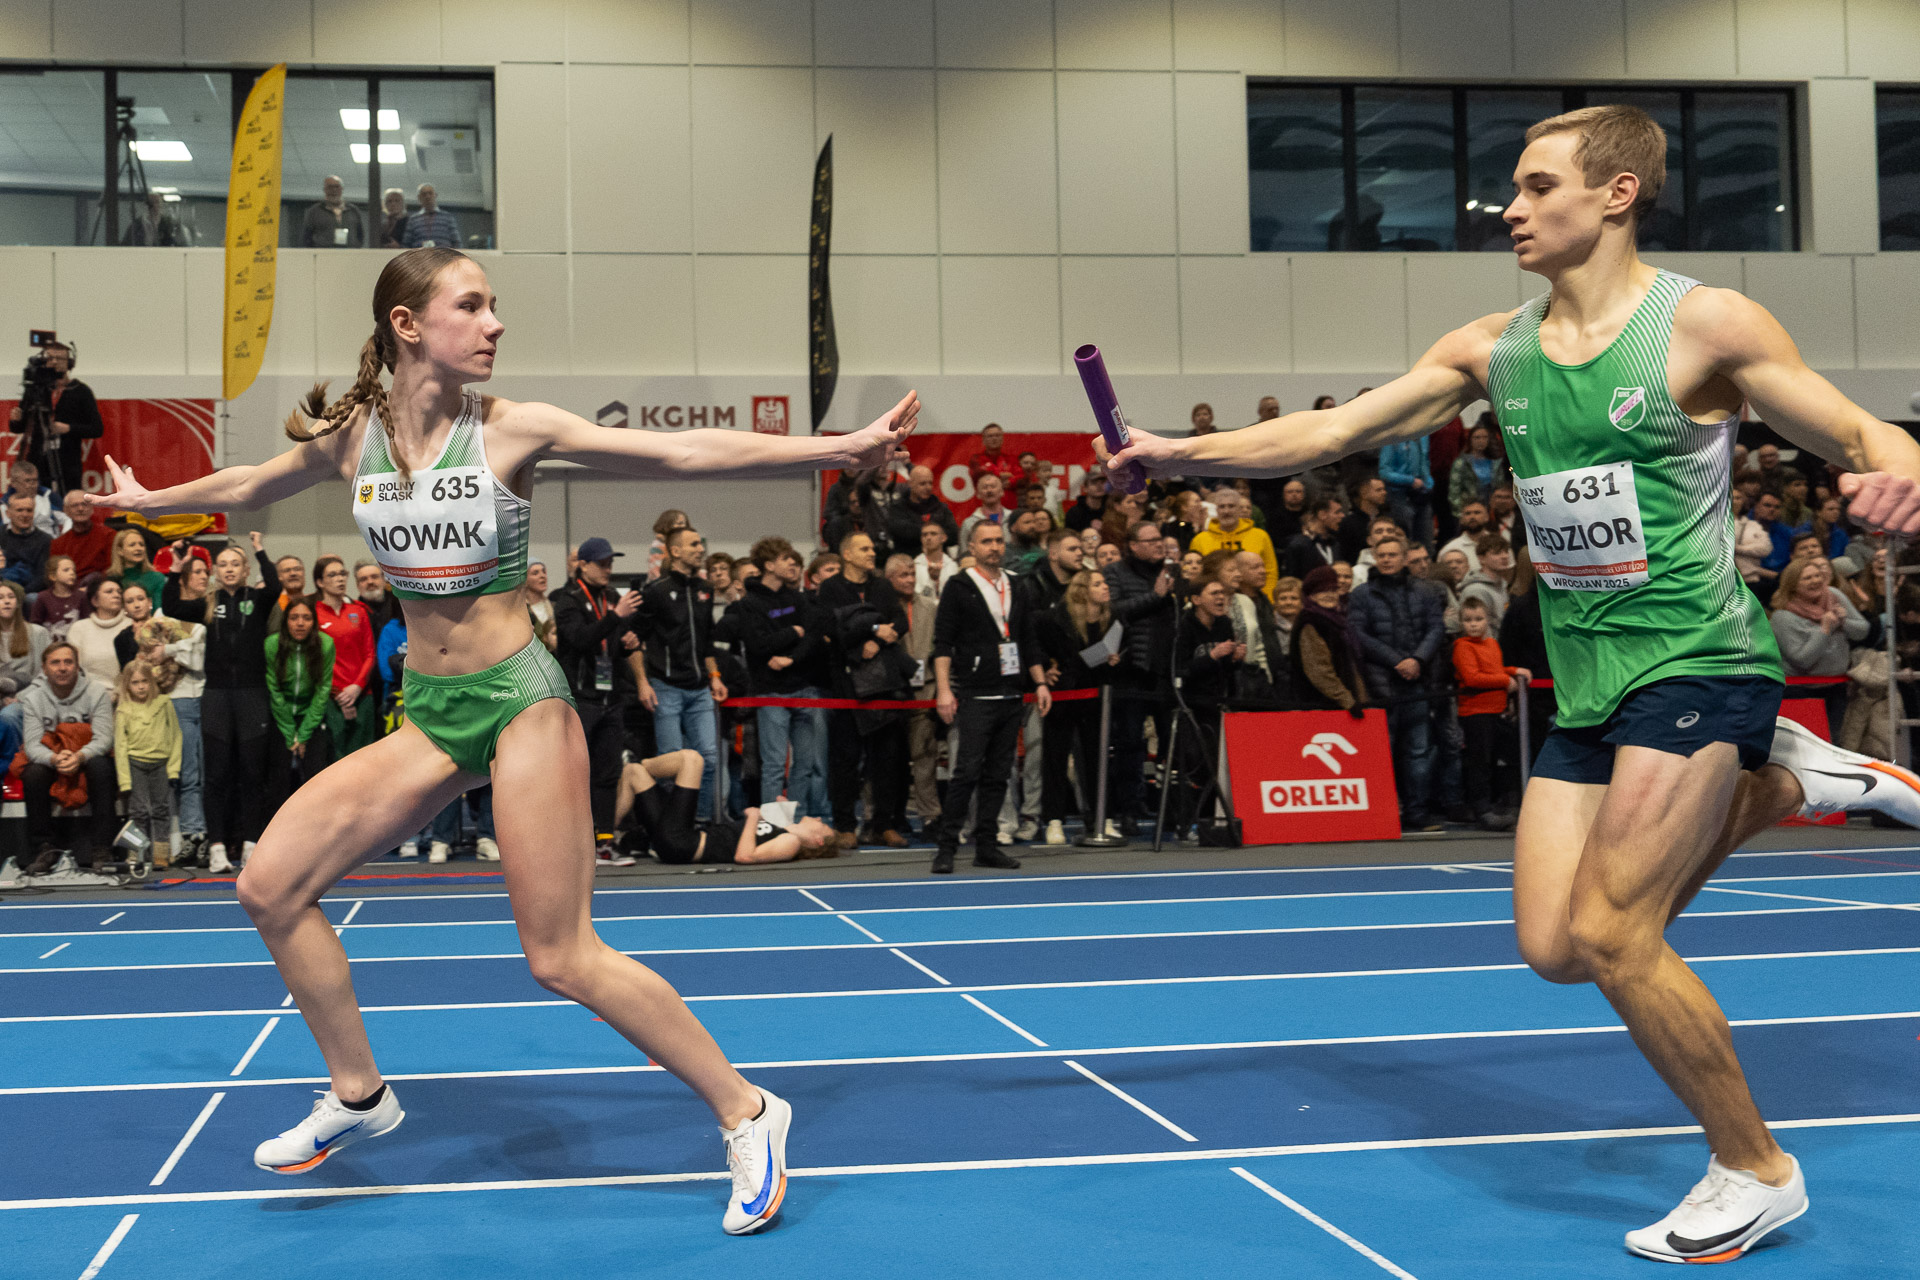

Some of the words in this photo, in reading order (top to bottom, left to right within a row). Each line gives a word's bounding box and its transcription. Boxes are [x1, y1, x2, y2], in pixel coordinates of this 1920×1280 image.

[1505, 398, 1528, 410] esa
[641, 405, 736, 428] KGHM
[378, 482, 415, 492] DOLNY
[431, 475, 480, 502] 635
[1562, 472, 1620, 503] 631
[368, 520, 486, 552] NOWAK
[1528, 517, 1637, 555] KĘDZIOR
[445, 567, 466, 576] Polski
[1552, 577, 1602, 589] WROCŁAW
[1604, 578, 1630, 588] 2025
[394, 578, 447, 591] WROCŁAW
[450, 576, 480, 590] 2025
[1269, 784, 1360, 807] ORLEN
